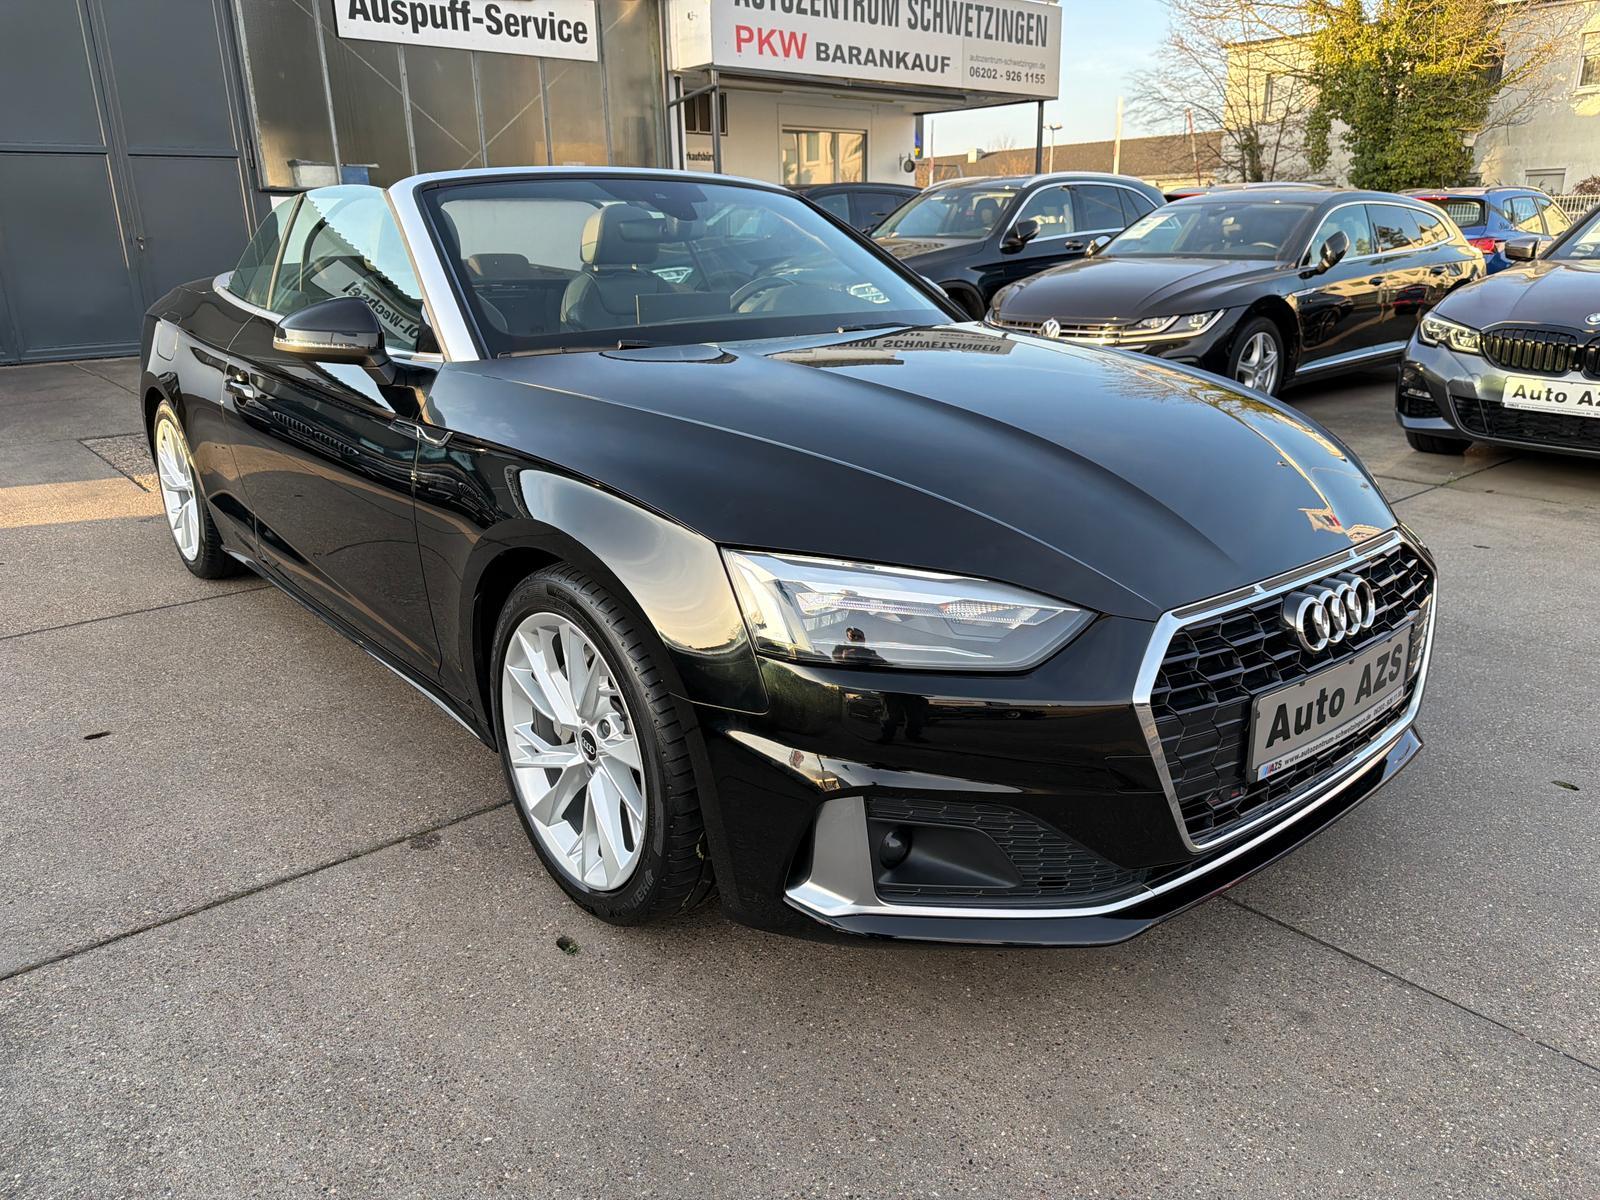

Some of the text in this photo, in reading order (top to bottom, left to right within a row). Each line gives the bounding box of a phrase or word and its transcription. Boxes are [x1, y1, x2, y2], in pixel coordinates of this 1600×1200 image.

[348, 0, 588, 44] Auspuff-Service
[907, 0, 1048, 47] SCHWETZINGEN
[735, 24, 952, 74] PKW BARANKAUF
[969, 66, 998, 79] 06202
[1005, 70, 1022, 82] 926
[1024, 72, 1046, 84] 1155
[1512, 384, 1600, 408] Auto A
[1265, 643, 1403, 748] Auto AZS
